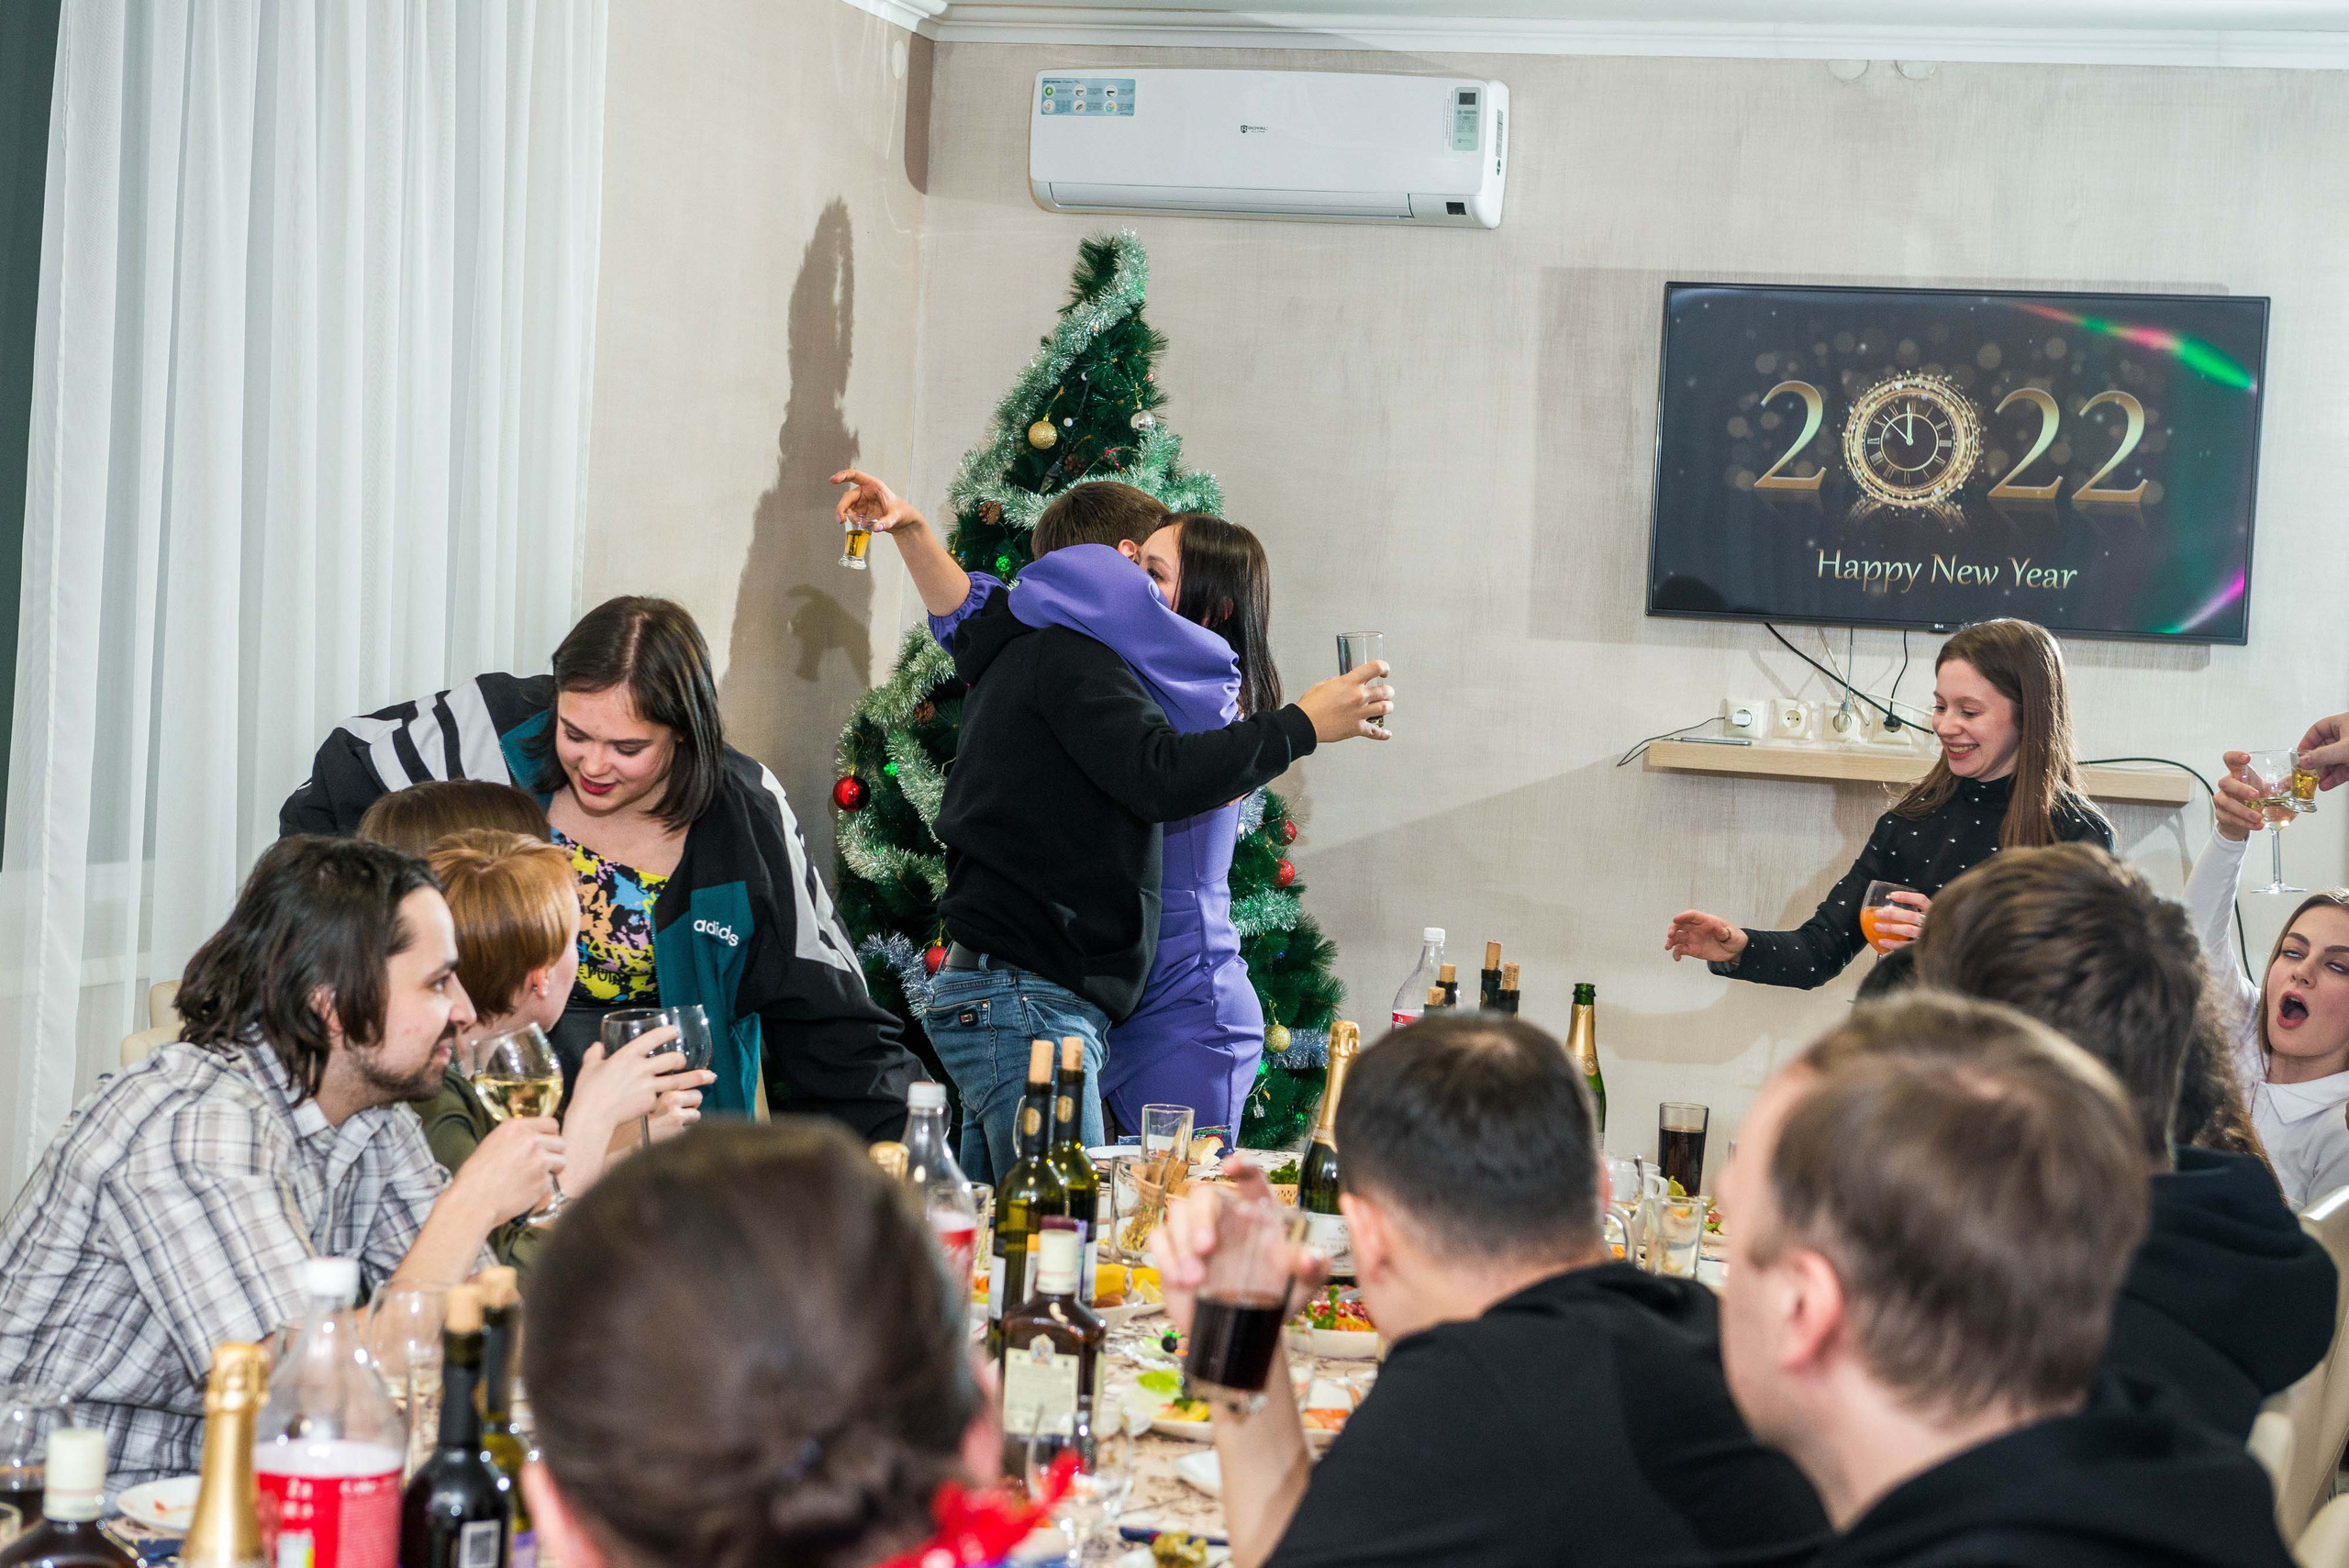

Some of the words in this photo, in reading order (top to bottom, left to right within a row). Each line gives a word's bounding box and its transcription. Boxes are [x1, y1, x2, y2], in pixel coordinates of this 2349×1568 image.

[1816, 548, 1922, 594] Happy
[1930, 553, 1999, 586] New
[2007, 556, 2077, 589] Year
[693, 918, 740, 947] adids
